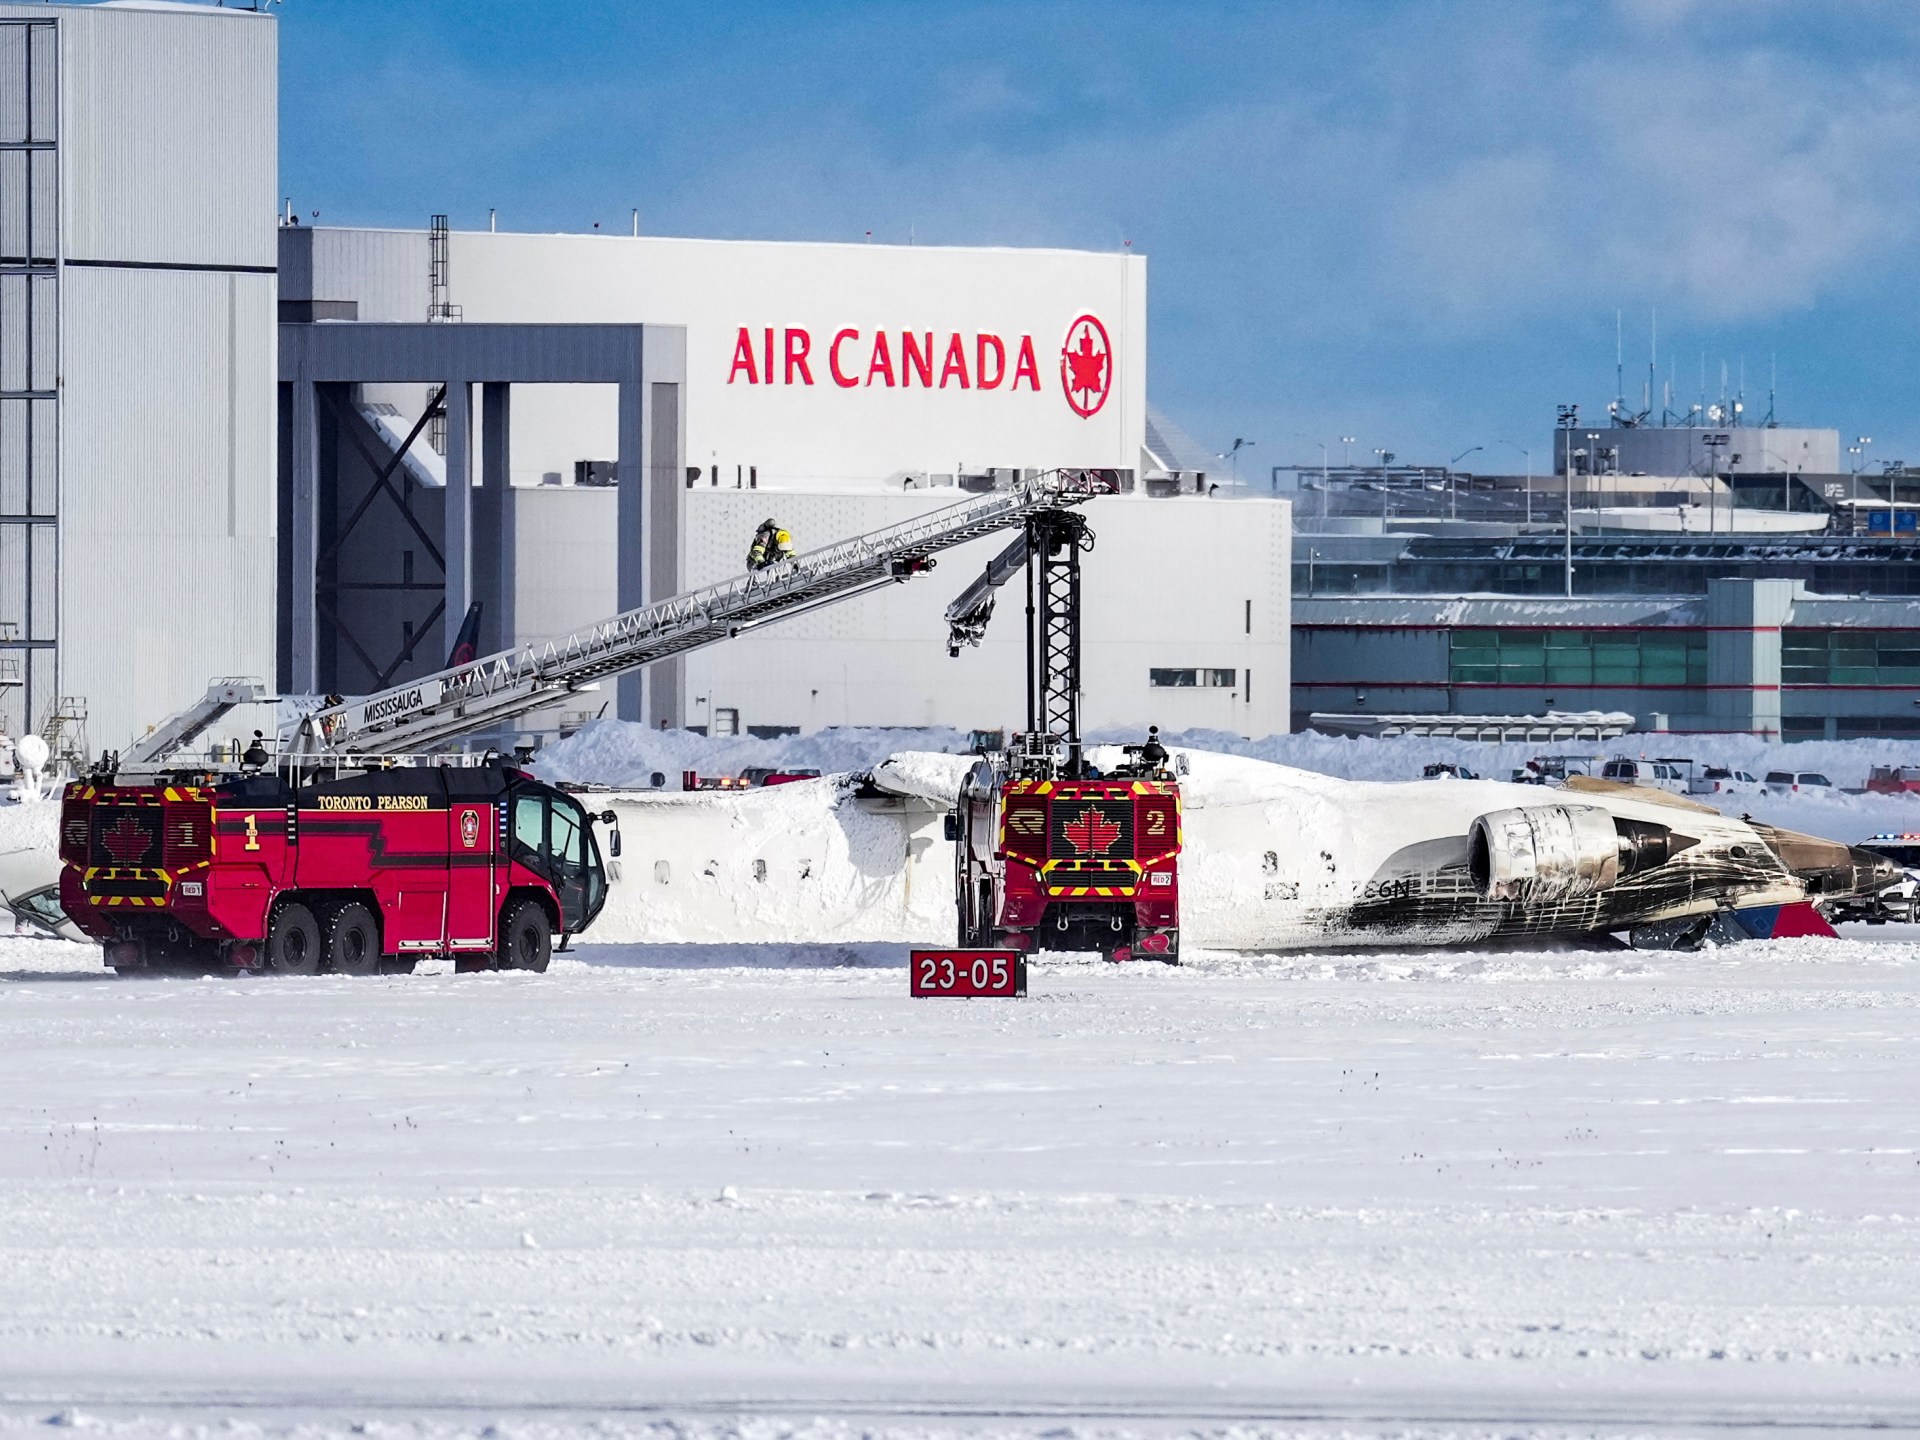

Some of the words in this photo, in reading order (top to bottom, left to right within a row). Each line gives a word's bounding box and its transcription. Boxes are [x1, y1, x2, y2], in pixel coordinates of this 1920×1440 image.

[727, 325, 814, 385] AIR
[829, 326, 1041, 391] CANADA
[364, 688, 423, 724] MISSISSAUGA
[317, 795, 371, 810] TORONTO
[377, 795, 428, 810] PEARSON
[244, 813, 260, 850] 1
[1146, 810, 1166, 835] 2
[1165, 876, 1170, 884] 2
[920, 959, 1008, 988] 23-05
